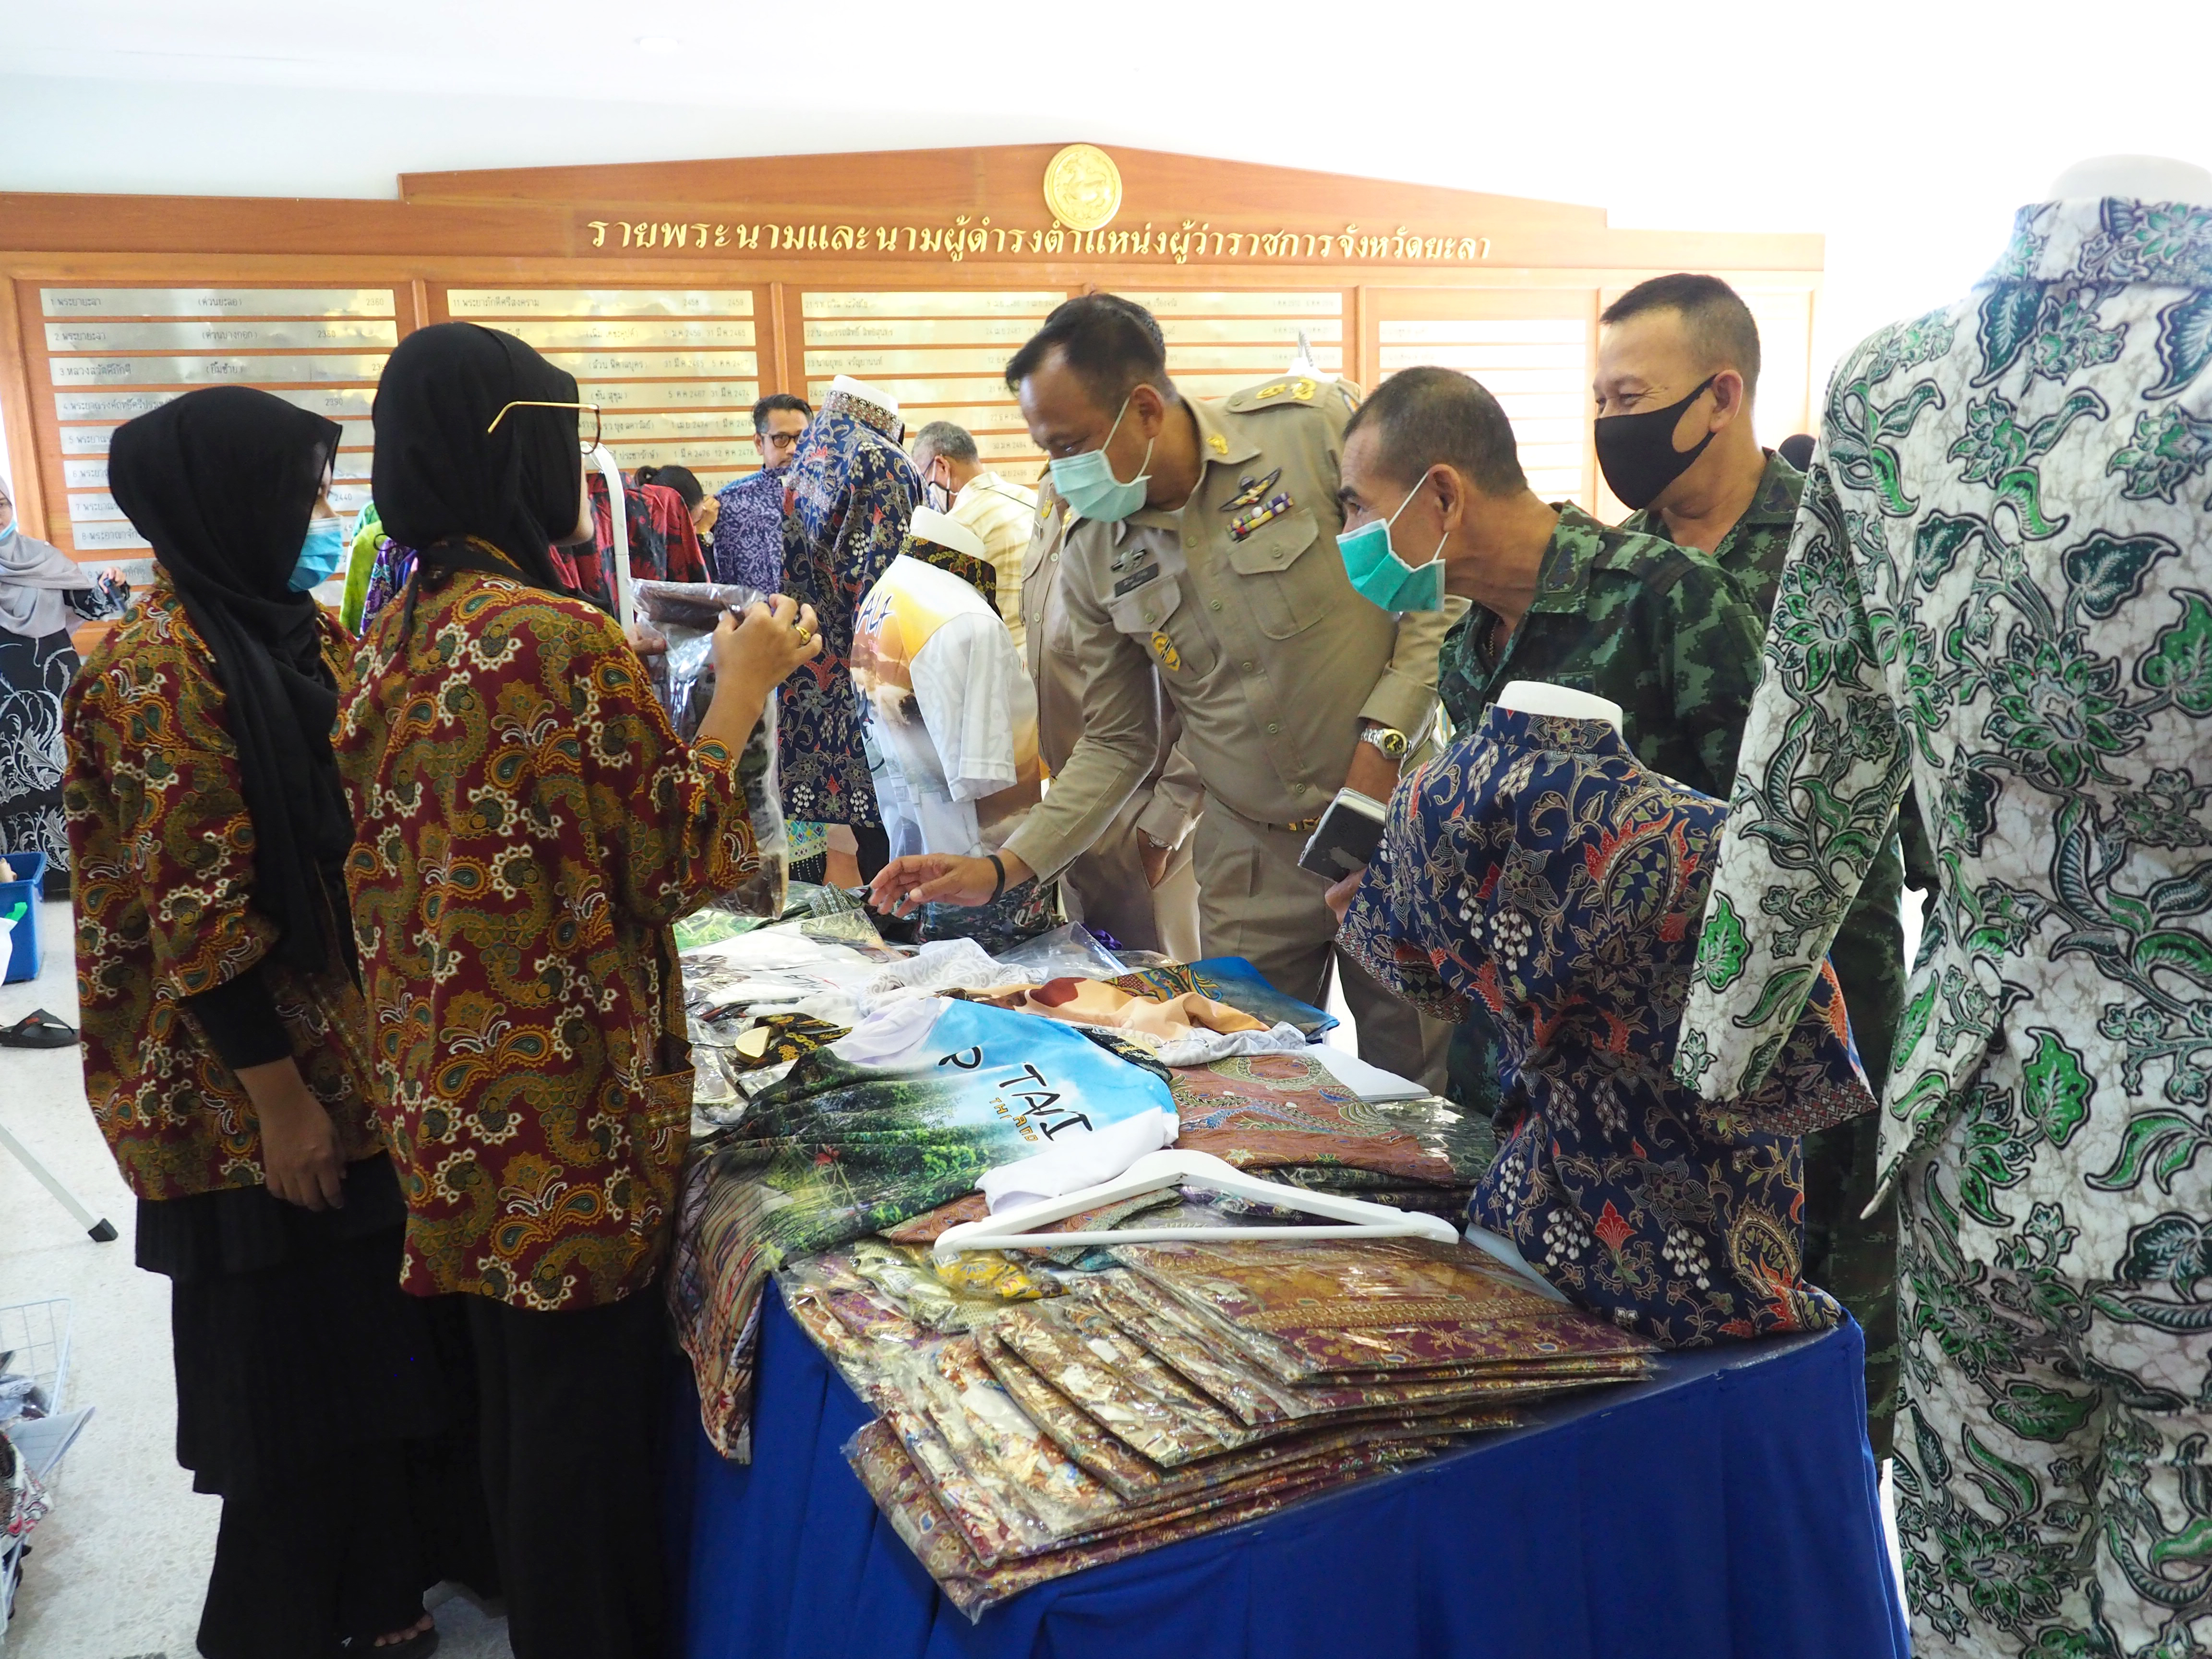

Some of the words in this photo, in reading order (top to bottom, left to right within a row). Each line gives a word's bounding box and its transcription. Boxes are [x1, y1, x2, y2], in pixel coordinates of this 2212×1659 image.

[587, 215, 1491, 264] รายพระนามและนามผู้ดำรงตำแหน่งผู้ว่าราชการจังหวัดยะลา
[58, 298, 101, 306] พระยายะลา
[366, 298, 384, 306] 2360
[62, 332, 106, 340] พระยายะลา
[60, 367, 64, 375] 3
[372, 363, 386, 372] 239
[76, 435, 111, 444] พระยาณร
[72, 469, 77, 478] 6
[89, 529, 139, 541] พระอาณาจัก
